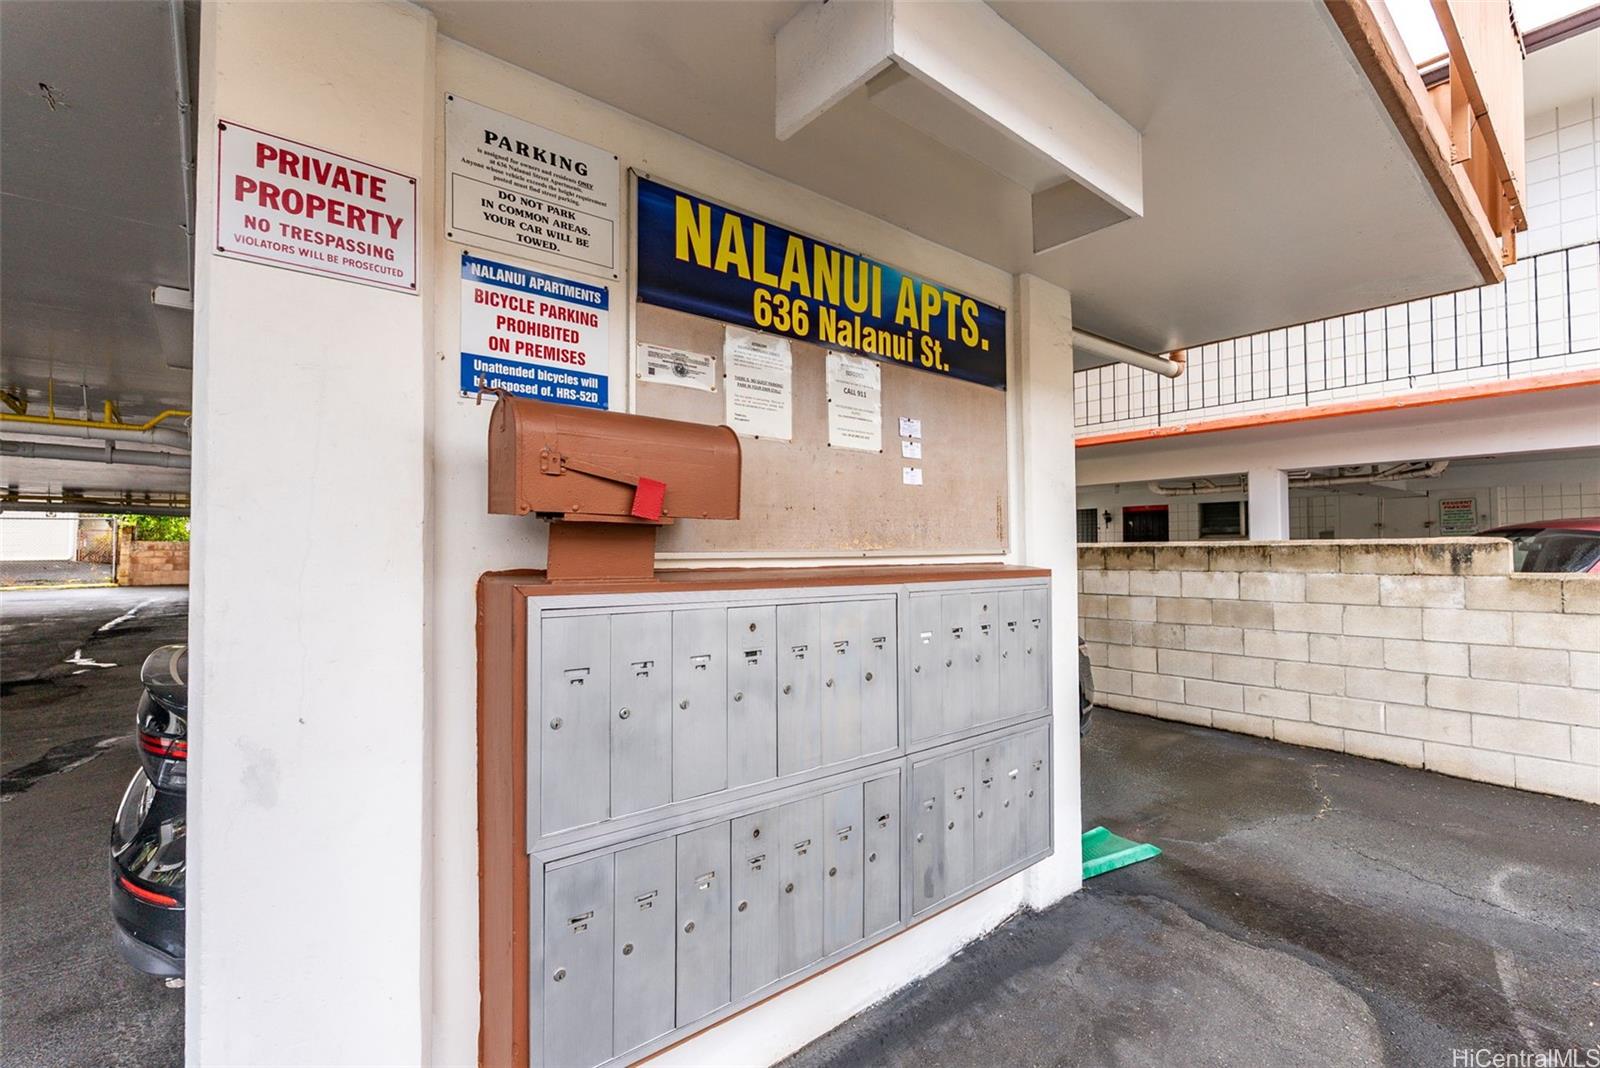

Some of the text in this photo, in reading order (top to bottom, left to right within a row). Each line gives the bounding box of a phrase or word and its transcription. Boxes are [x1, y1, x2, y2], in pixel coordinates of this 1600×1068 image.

[256, 142, 387, 202] PRIVATE
[484, 130, 588, 177] PARKING
[484, 150, 509, 162] assigned
[520, 162, 540, 172] owners
[553, 173, 577, 184] residents
[577, 180, 594, 191] ONLY
[509, 165, 531, 176] Nalanui
[532, 172, 549, 181] Street
[461, 157, 485, 168] Anyone
[486, 166, 504, 174] whose
[505, 172, 525, 181] vehicle
[526, 179, 548, 188] exceeds
[558, 188, 575, 197] height
[575, 194, 607, 207] requirement
[493, 175, 513, 185] posted
[529, 185, 541, 193] find
[541, 190, 557, 198] street
[235, 174, 404, 240] PROPERTY
[481, 198, 591, 237] IN COMMON AREAS.
[498, 190, 576, 221] DO NOT PARK
[244, 215, 395, 261] NO TRESPASSING
[482, 211, 590, 248] YOUR CAR WILL BE
[516, 233, 560, 252] TOWED.
[234, 233, 404, 278] VIOLATORS WILL BE PROSECUTED
[674, 195, 990, 351] NALANUI APTS.
[471, 262, 602, 304] NALANUI APARTMENTS
[474, 288, 599, 328] BICYCLE PARKING
[496, 315, 580, 344] PROHIBITED
[753, 288, 809, 337] 636
[818, 306, 913, 363] Nalanui
[920, 334, 950, 372] St.
[488, 336, 586, 366] ON PREMISES
[473, 359, 599, 389] Unattended bicycles will
[473, 375, 488, 388] be
[490, 378, 538, 396] disposed
[540, 385, 554, 397] of.
[843, 387, 867, 398] CALL 911
